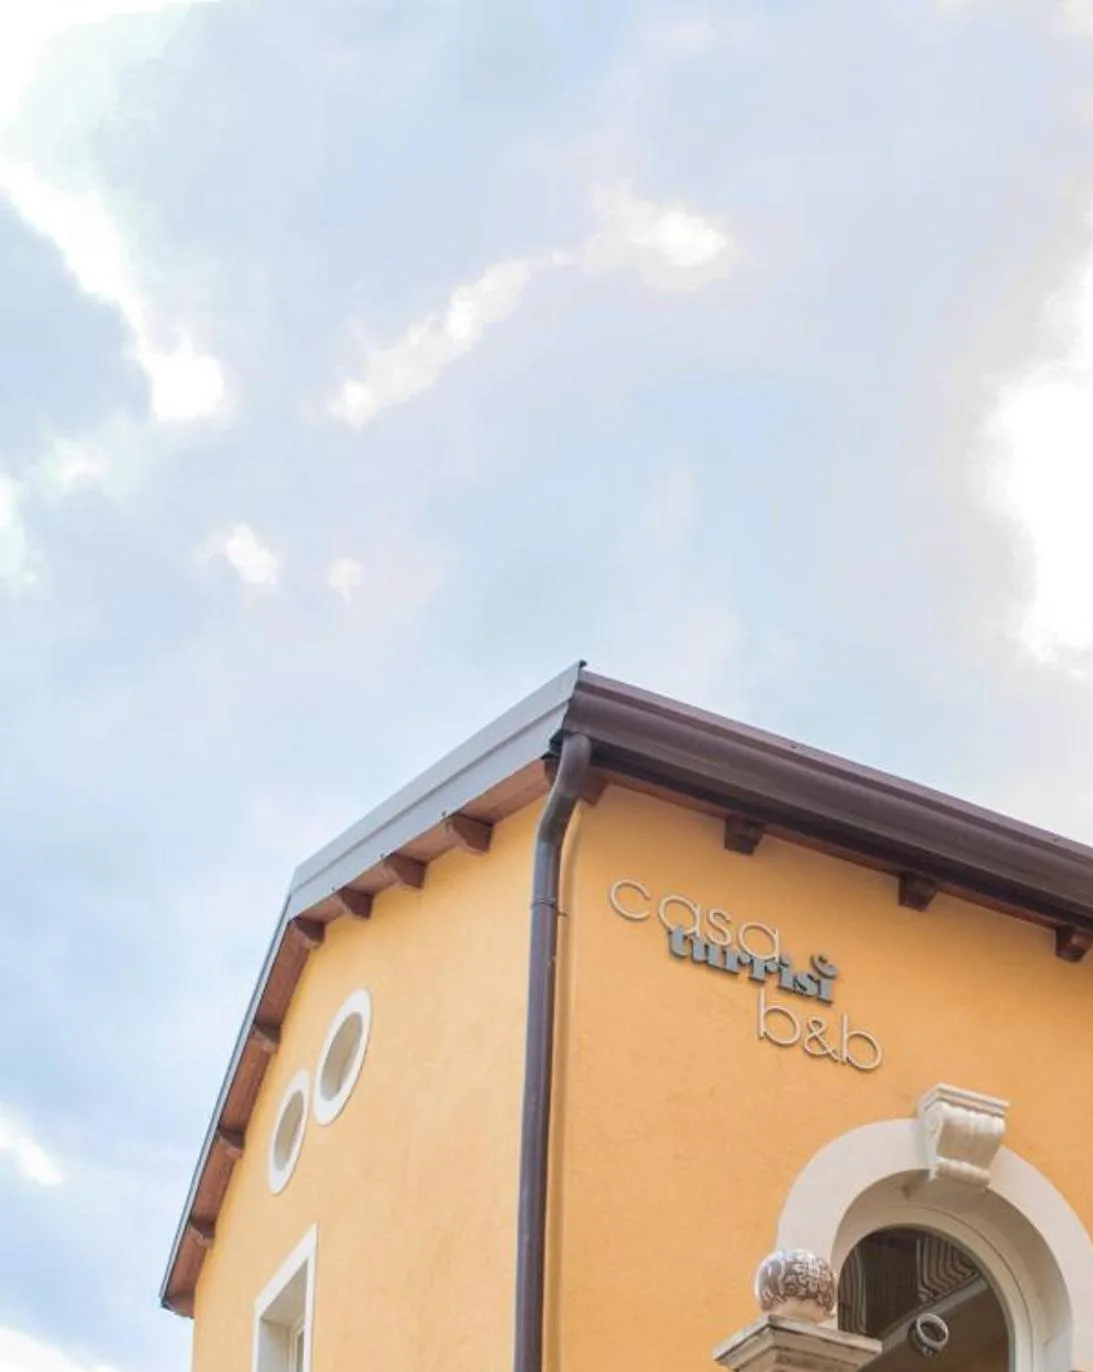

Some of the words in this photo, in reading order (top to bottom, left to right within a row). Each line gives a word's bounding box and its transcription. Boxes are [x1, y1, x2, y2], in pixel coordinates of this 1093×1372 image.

[610, 879, 781, 964] casa
[667, 924, 838, 1006] turrisi
[758, 987, 883, 1071] b&b
